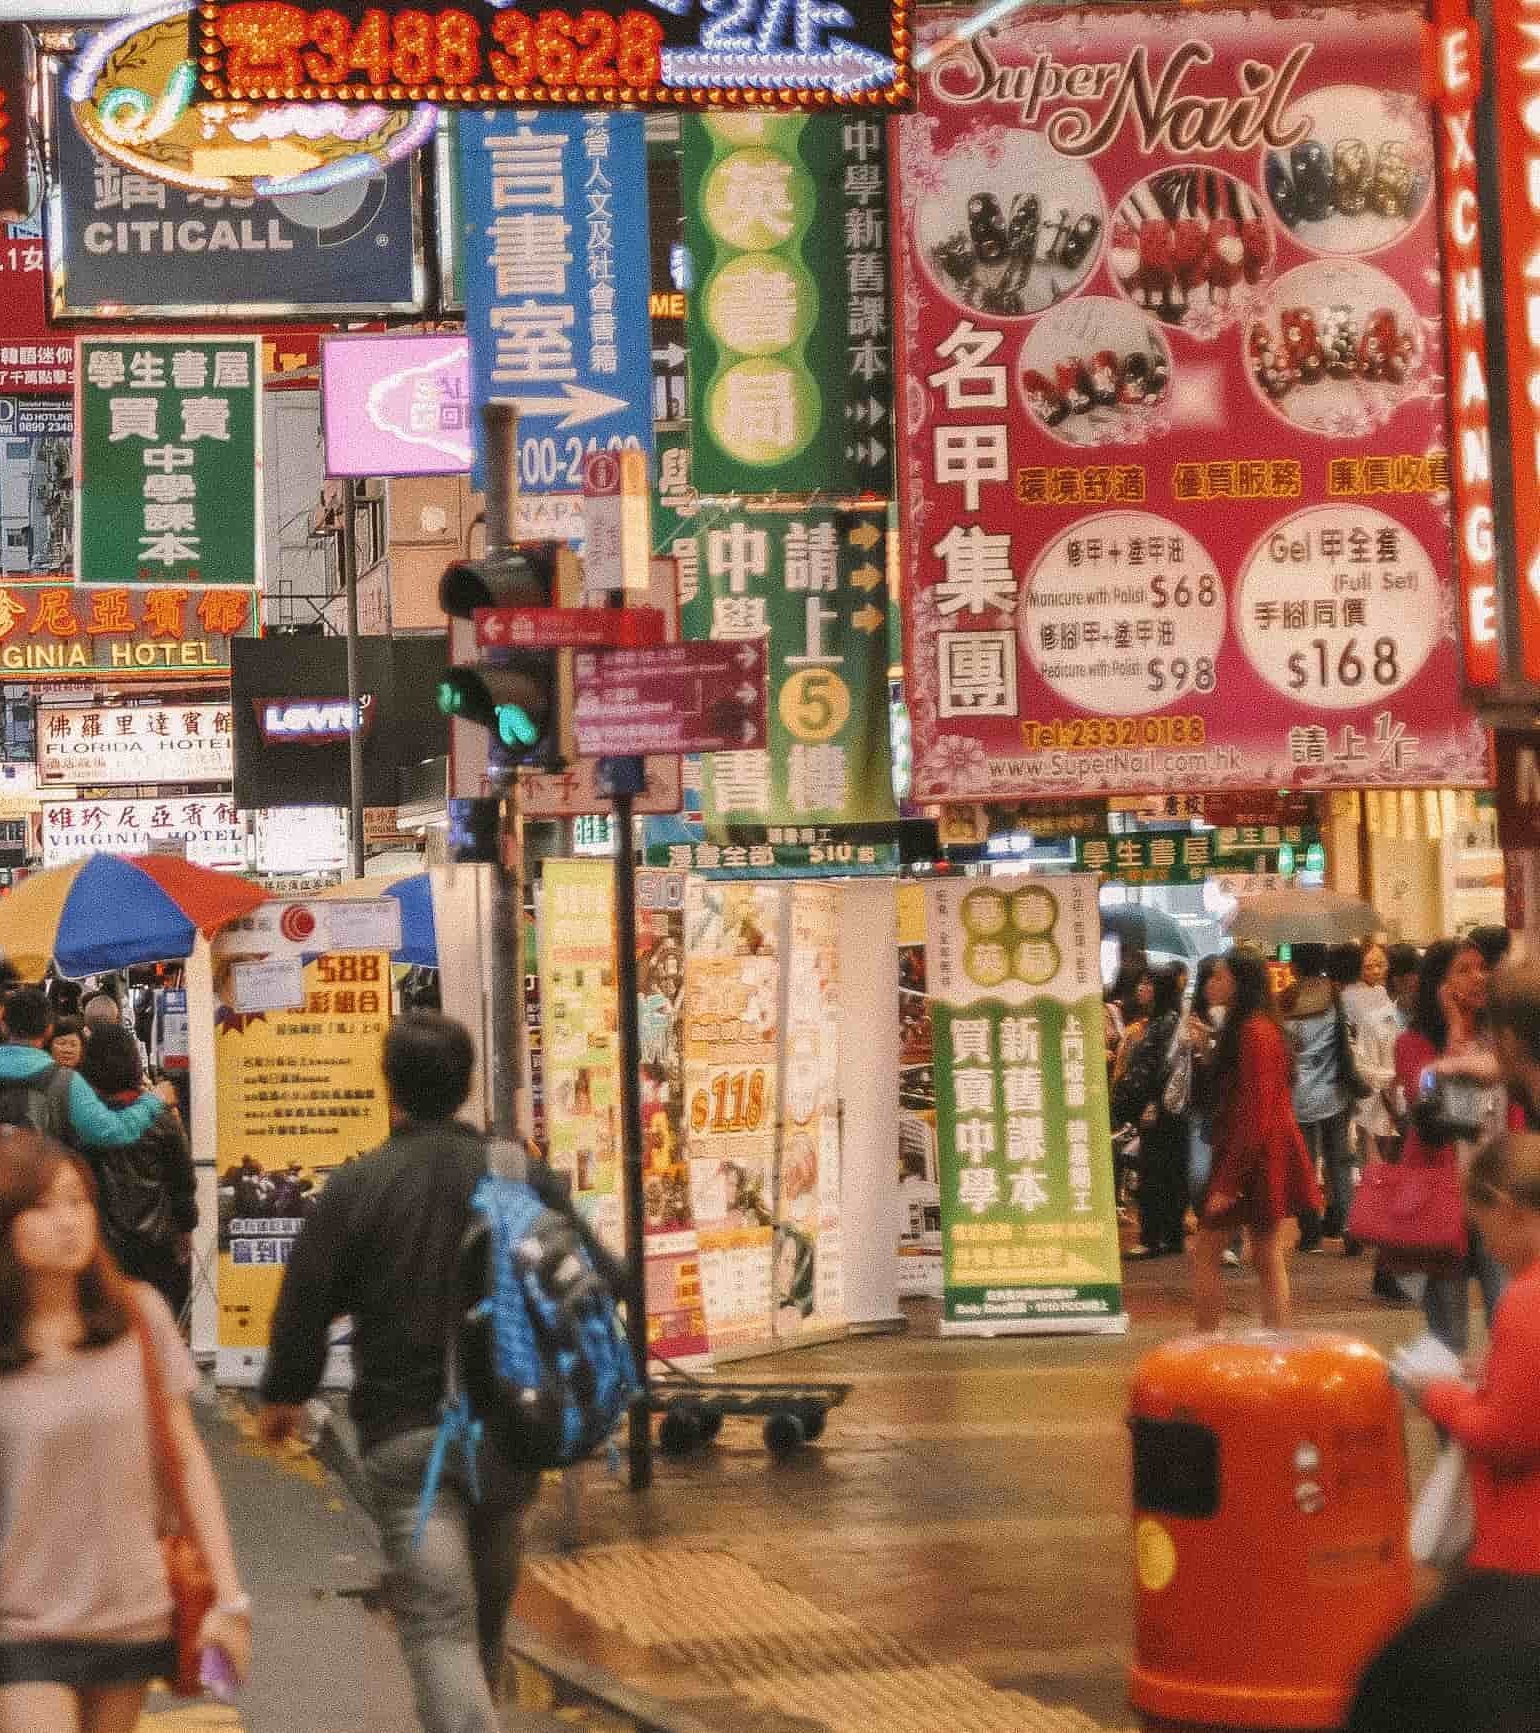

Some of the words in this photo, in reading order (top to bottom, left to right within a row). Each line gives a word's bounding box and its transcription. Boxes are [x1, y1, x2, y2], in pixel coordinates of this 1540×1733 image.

[301, 8, 480, 86] 3488
[489, 8, 663, 87] 3628
[932, 27, 1120, 123] Super
[1048, 41, 1314, 156] Nail
[83, 218, 294, 253] CITICALL
[482, 112, 577, 381] 言書室
[1444, 30, 1500, 642] EXCHANGE
[87, 350, 250, 389] 學生書屋
[108, 397, 231, 442] 買賣
[137, 443, 202, 566] 中學課本
[930, 322, 1017, 716] 名甲集團
[1269, 529, 1310, 564] Gel
[1320, 526, 1399, 563] 甲全套
[1149, 573, 1217, 609] $68
[111, 641, 219, 666] HOTEL
[1287, 636, 1400, 692] $168
[1147, 655, 1216, 692] $98
[48, 711, 235, 738] 佛羅里達賓館
[47, 740, 144, 754] FLORIDA
[49, 833, 150, 850] VIRGINIA
